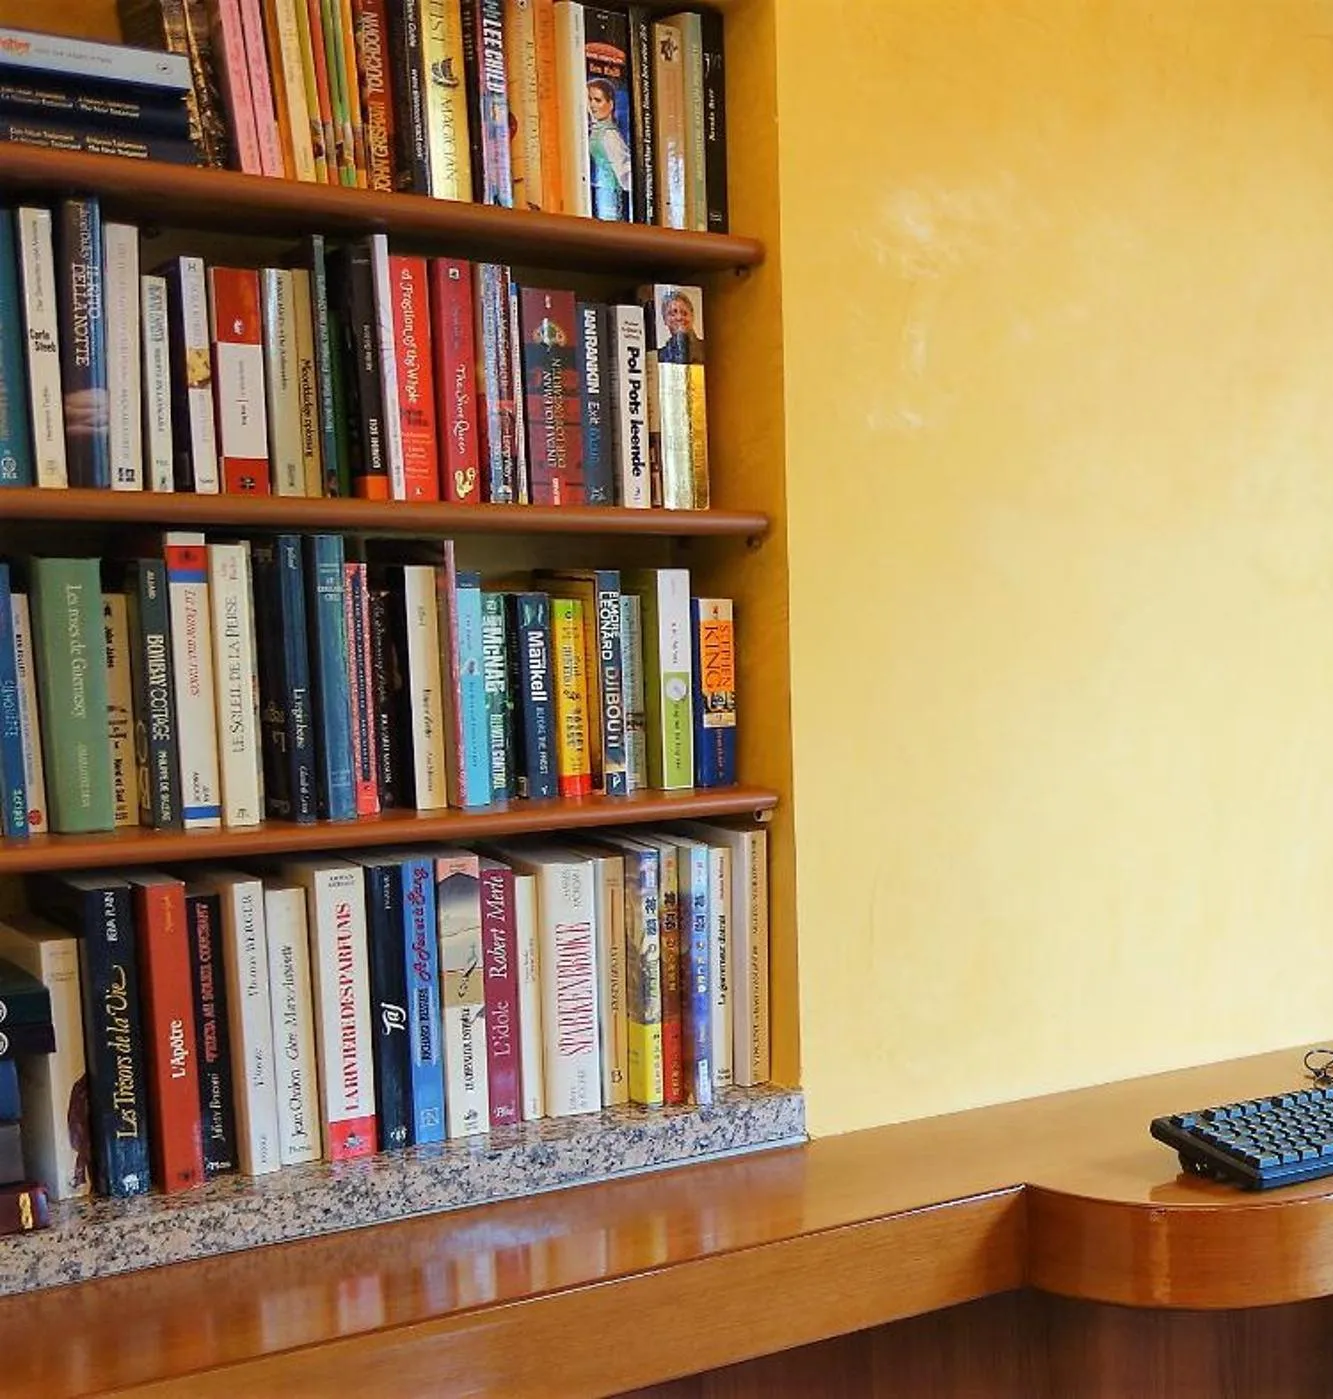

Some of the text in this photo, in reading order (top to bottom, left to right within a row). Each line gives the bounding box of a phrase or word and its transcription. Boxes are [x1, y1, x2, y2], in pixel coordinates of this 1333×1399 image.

[360, 11, 386, 95] TOUCHDOWN
[482, 18, 506, 95] LEE CHILD
[440, 96, 459, 182] MAGICIAN
[371, 159, 393, 193] JOHN
[71, 262, 90, 368] DELLA NOTTE
[455, 363, 466, 389] The
[583, 309, 600, 394] IAN RANKIN
[626, 345, 644, 374] Pol
[586, 400, 601, 425] Exit
[627, 378, 643, 416] Pots
[453, 418, 470, 455] Queen
[629, 418, 646, 478] leende
[70, 639, 85, 656] de
[599, 590, 613, 661] LEONARD
[608, 590, 619, 639] ELMORE
[146, 633, 170, 741] BOMBAY COTTAGE
[527, 630, 548, 702] Mankell
[704, 625, 720, 690] KING
[719, 624, 731, 688] STEPHEN
[604, 665, 621, 749] DJIBOUTI
[335, 902, 354, 988] PARFUMS
[483, 875, 509, 979] Robert Merle
[554, 920, 595, 1058] SPARKENBROKE
[104, 963, 139, 1140] Les Trésors de la Vie
[167, 1019, 189, 1080] L'Apôtre
[492, 1000, 512, 1057] L'idole
